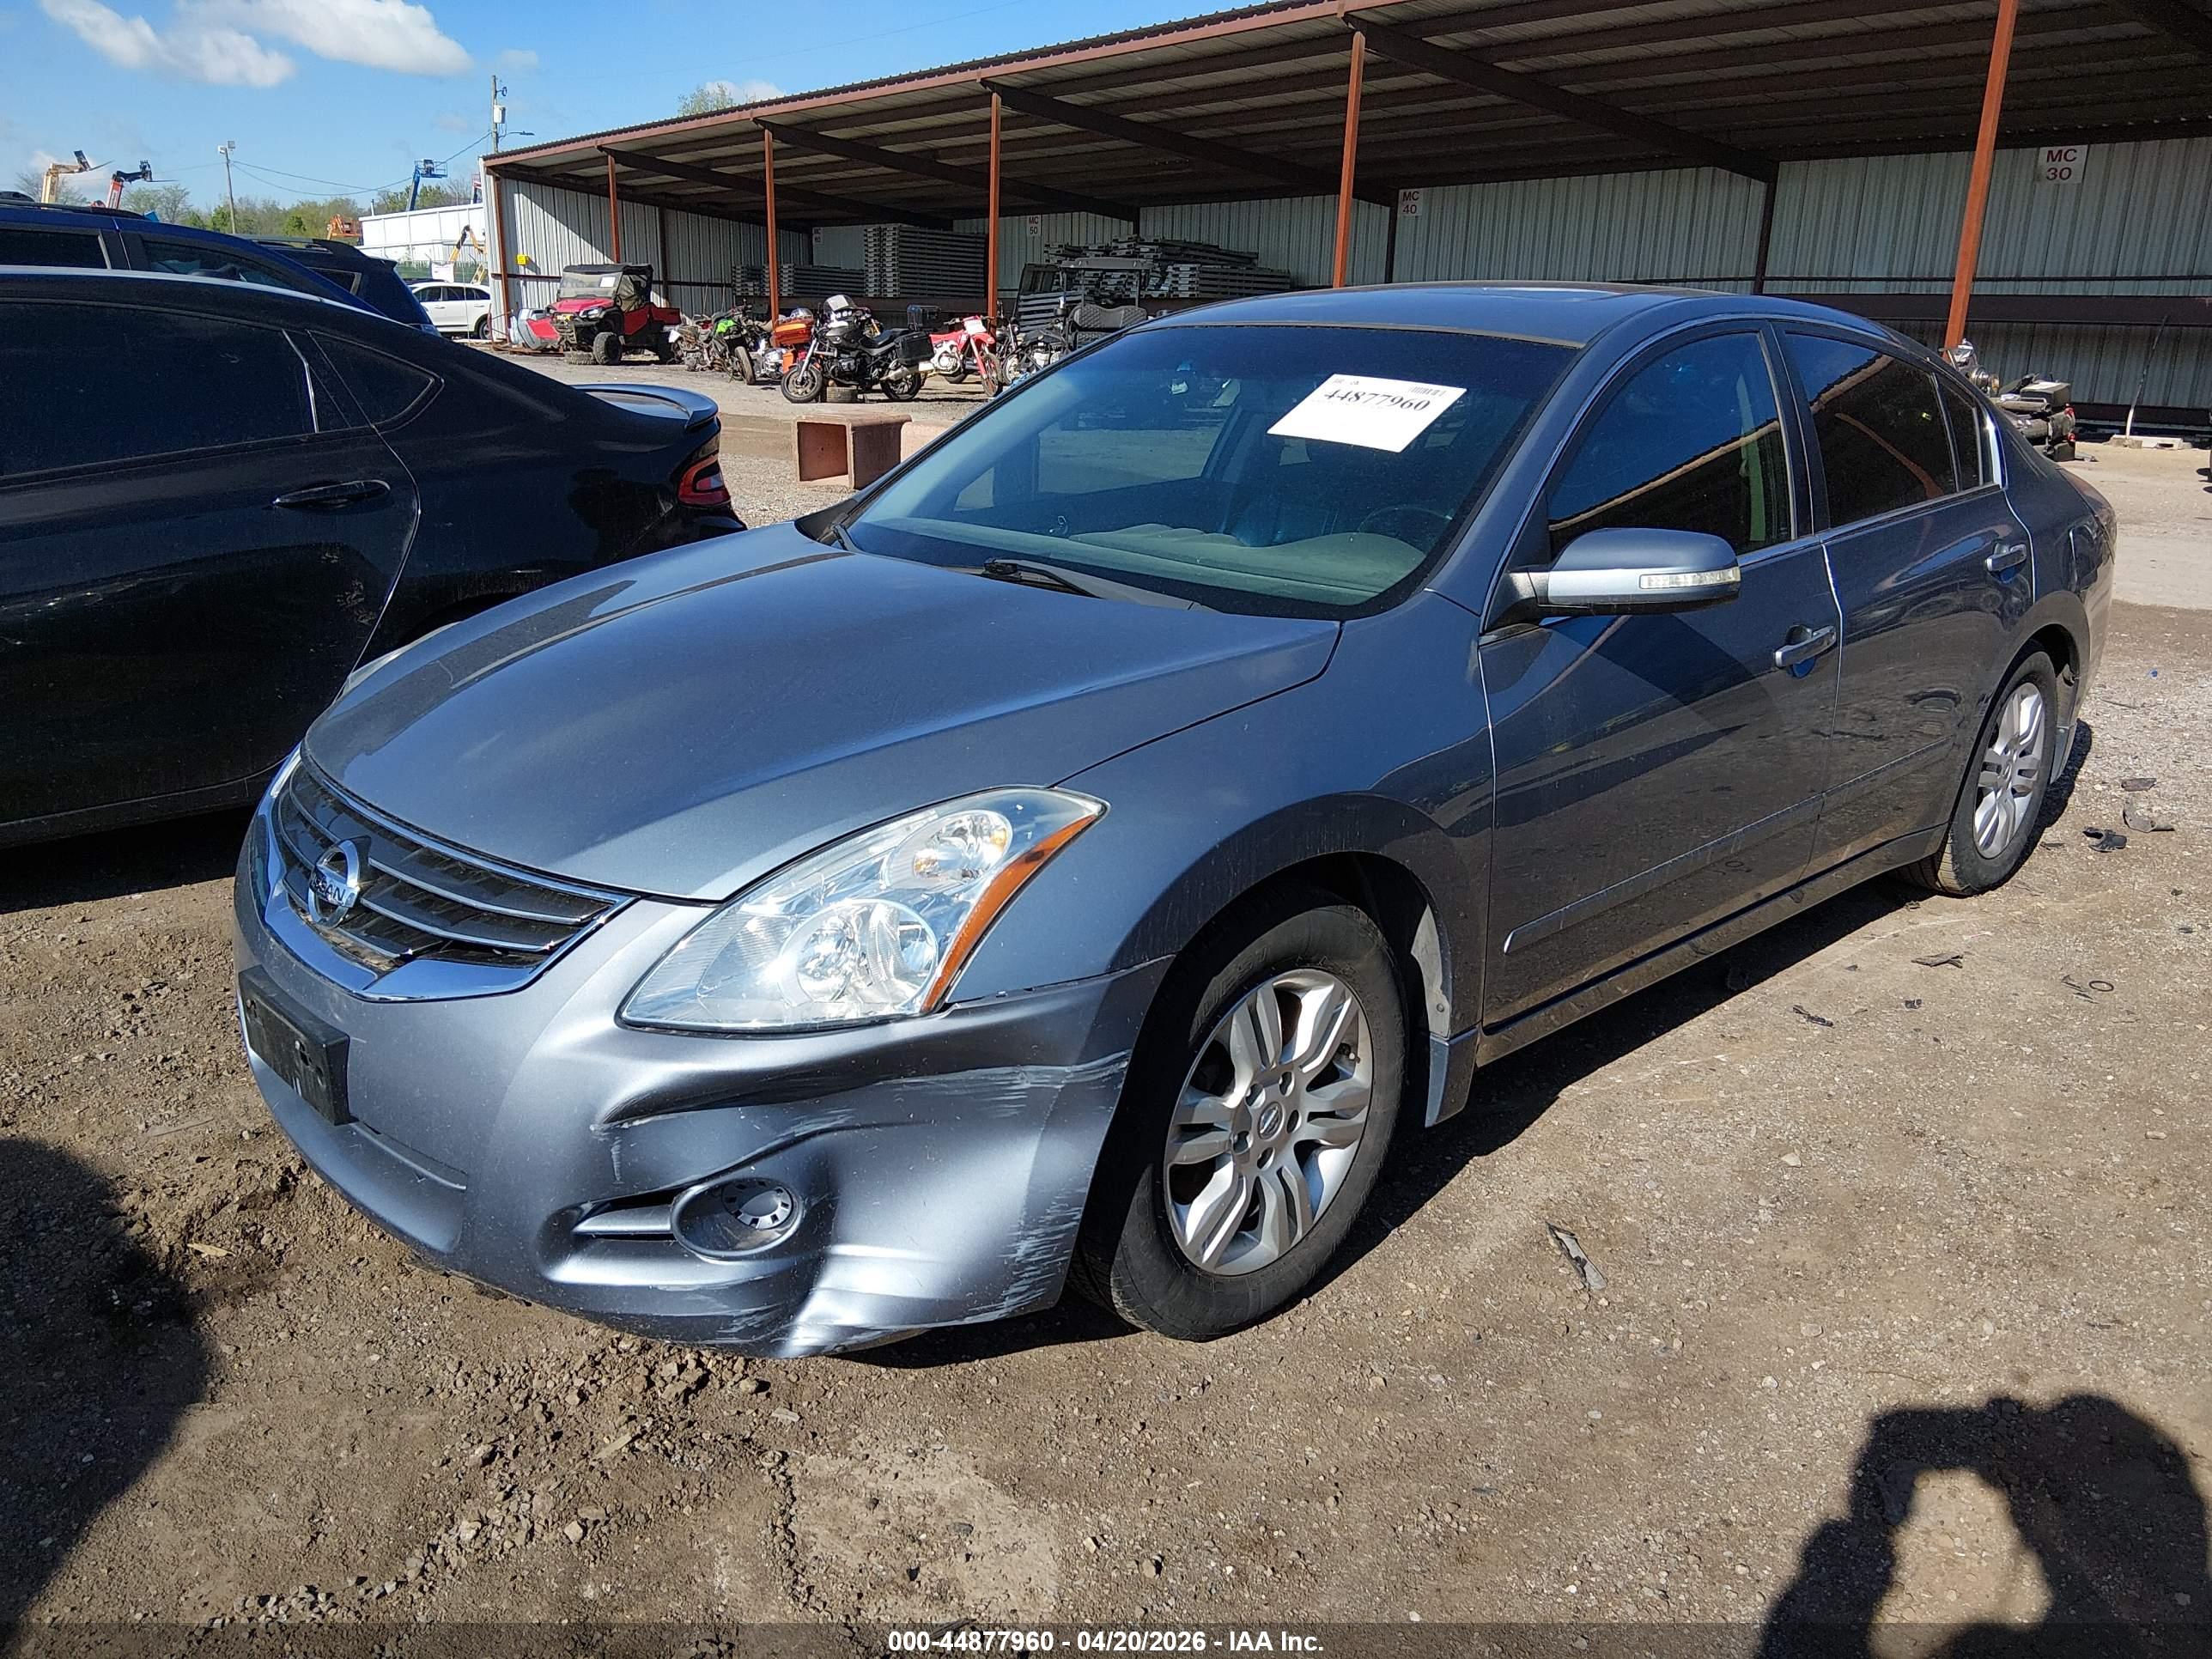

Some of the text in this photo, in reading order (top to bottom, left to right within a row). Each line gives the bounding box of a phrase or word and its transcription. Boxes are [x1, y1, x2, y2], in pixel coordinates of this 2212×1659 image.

[2047, 149, 2077, 162] MC
[2046, 167, 2072, 180] 30
[1402, 191, 1419, 201] MC
[1403, 204, 1417, 214] 40
[1324, 389, 1431, 411] 44877960
